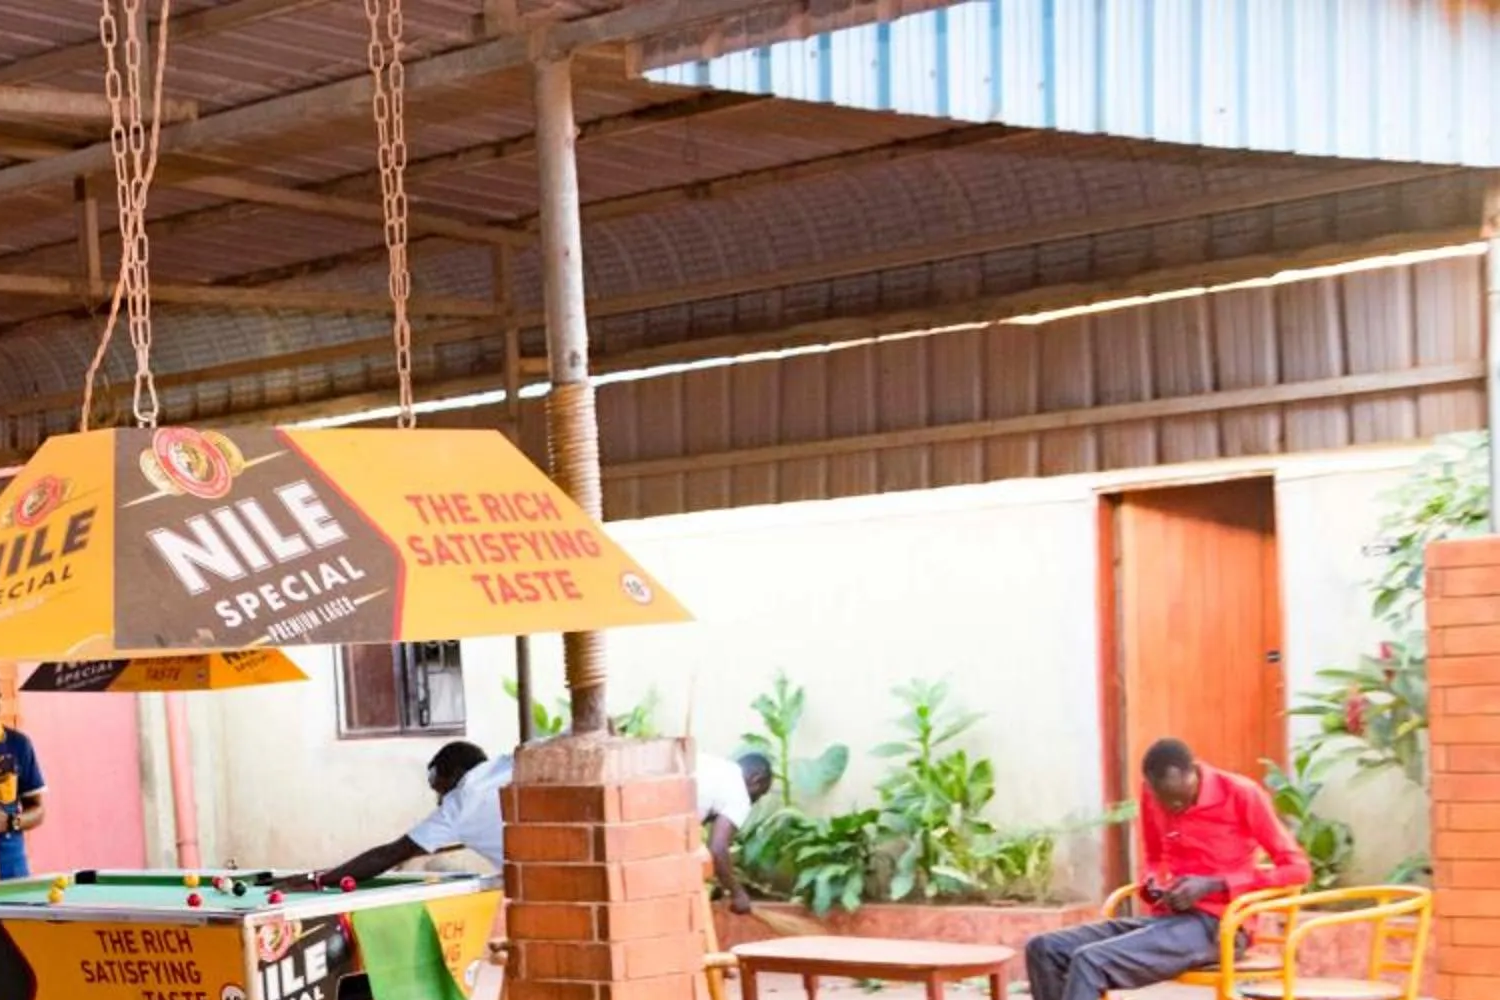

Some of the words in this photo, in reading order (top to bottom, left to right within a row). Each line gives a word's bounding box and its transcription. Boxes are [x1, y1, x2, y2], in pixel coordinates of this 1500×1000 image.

[405, 493, 479, 525] THE
[481, 491, 563, 524] RICH
[146, 480, 350, 596] NILE
[406, 528, 603, 567] SATISFYING
[214, 555, 366, 628] SPECIAL
[471, 570, 583, 605] TASTE
[94, 929, 138, 954] THE
[141, 928, 194, 954] RICH
[80, 960, 203, 985] SATISFYING
